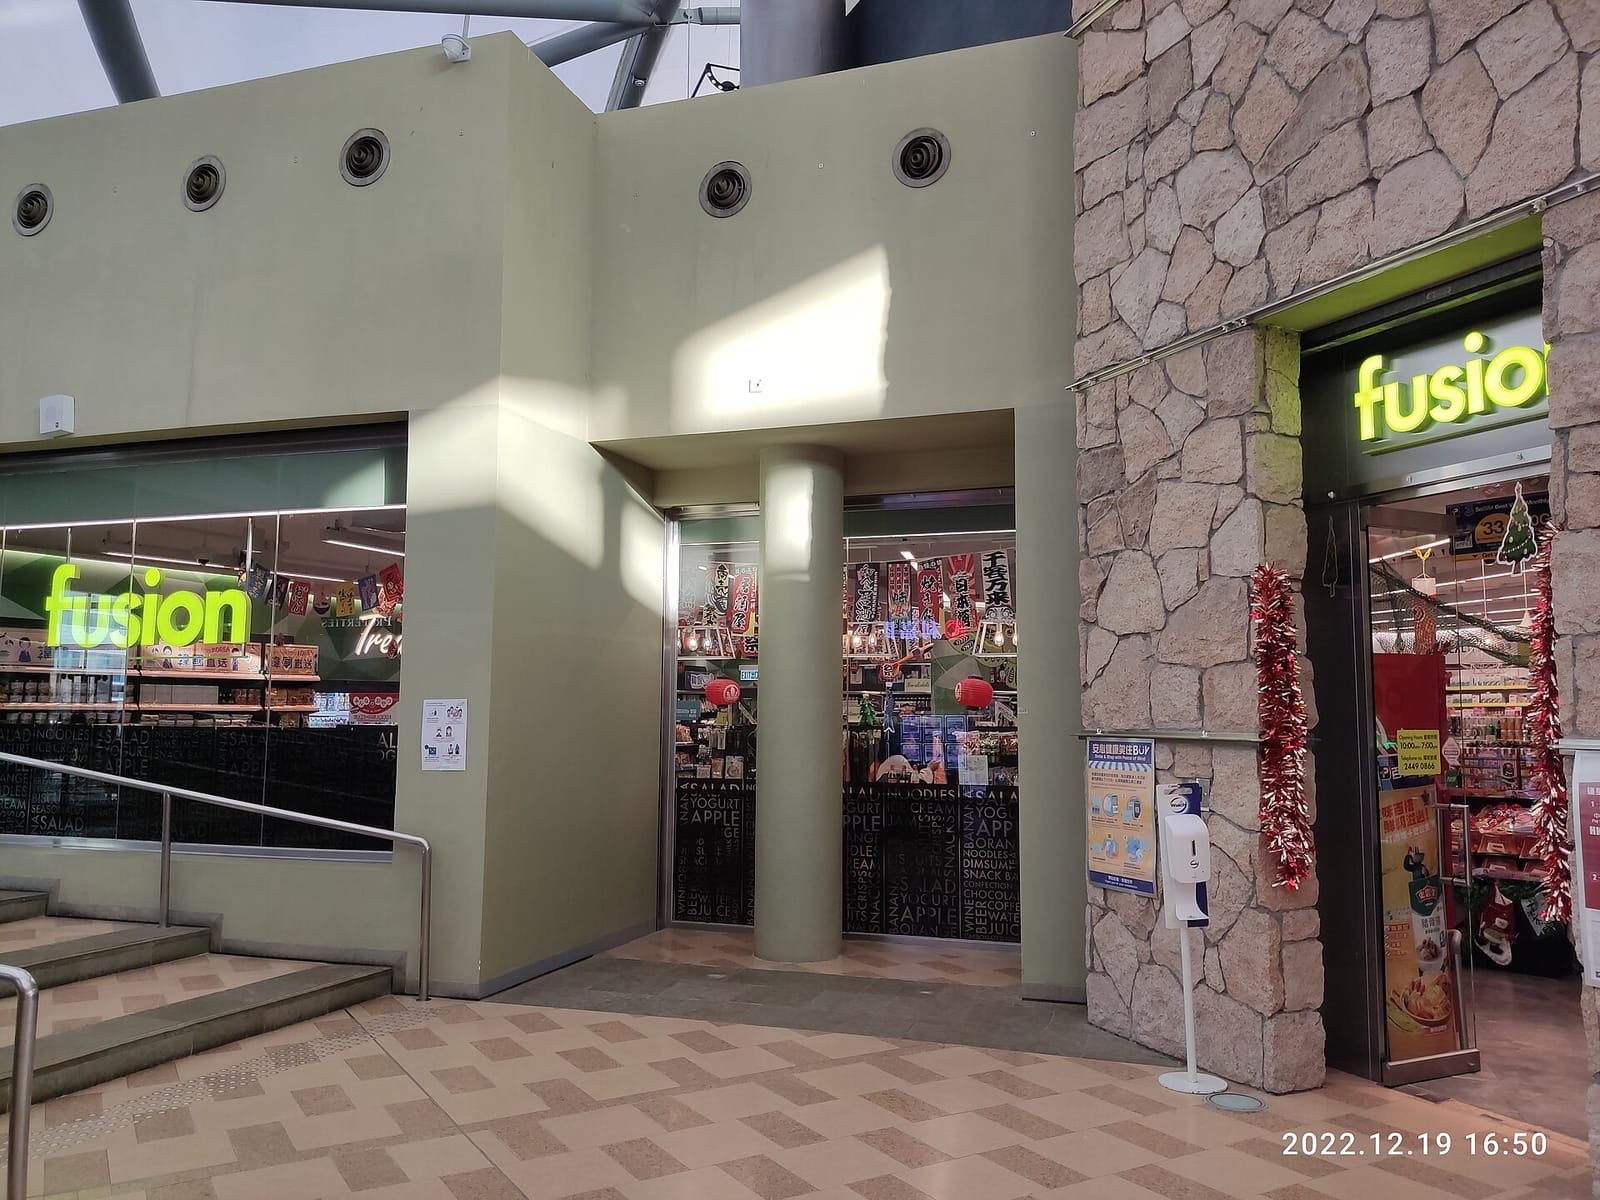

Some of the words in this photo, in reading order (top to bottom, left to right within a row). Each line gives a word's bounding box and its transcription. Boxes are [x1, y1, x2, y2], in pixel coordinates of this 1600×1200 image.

[1354, 331, 1550, 441] fusio
[1483, 520, 1504, 535] 33
[46, 563, 251, 648] fusion
[104, 729, 150, 746] SALAD
[690, 799, 740, 810] YOGURT
[40, 815, 85, 832] SALAD
[690, 811, 740, 827] APPLE
[963, 850, 1009, 859] NOODLES
[963, 859, 1010, 871] DIMSUM
[963, 870, 1002, 881] SNACK
[900, 905, 957, 926] APPLE
[965, 899, 976, 934] WINE
[975, 900, 987, 935] BEER
